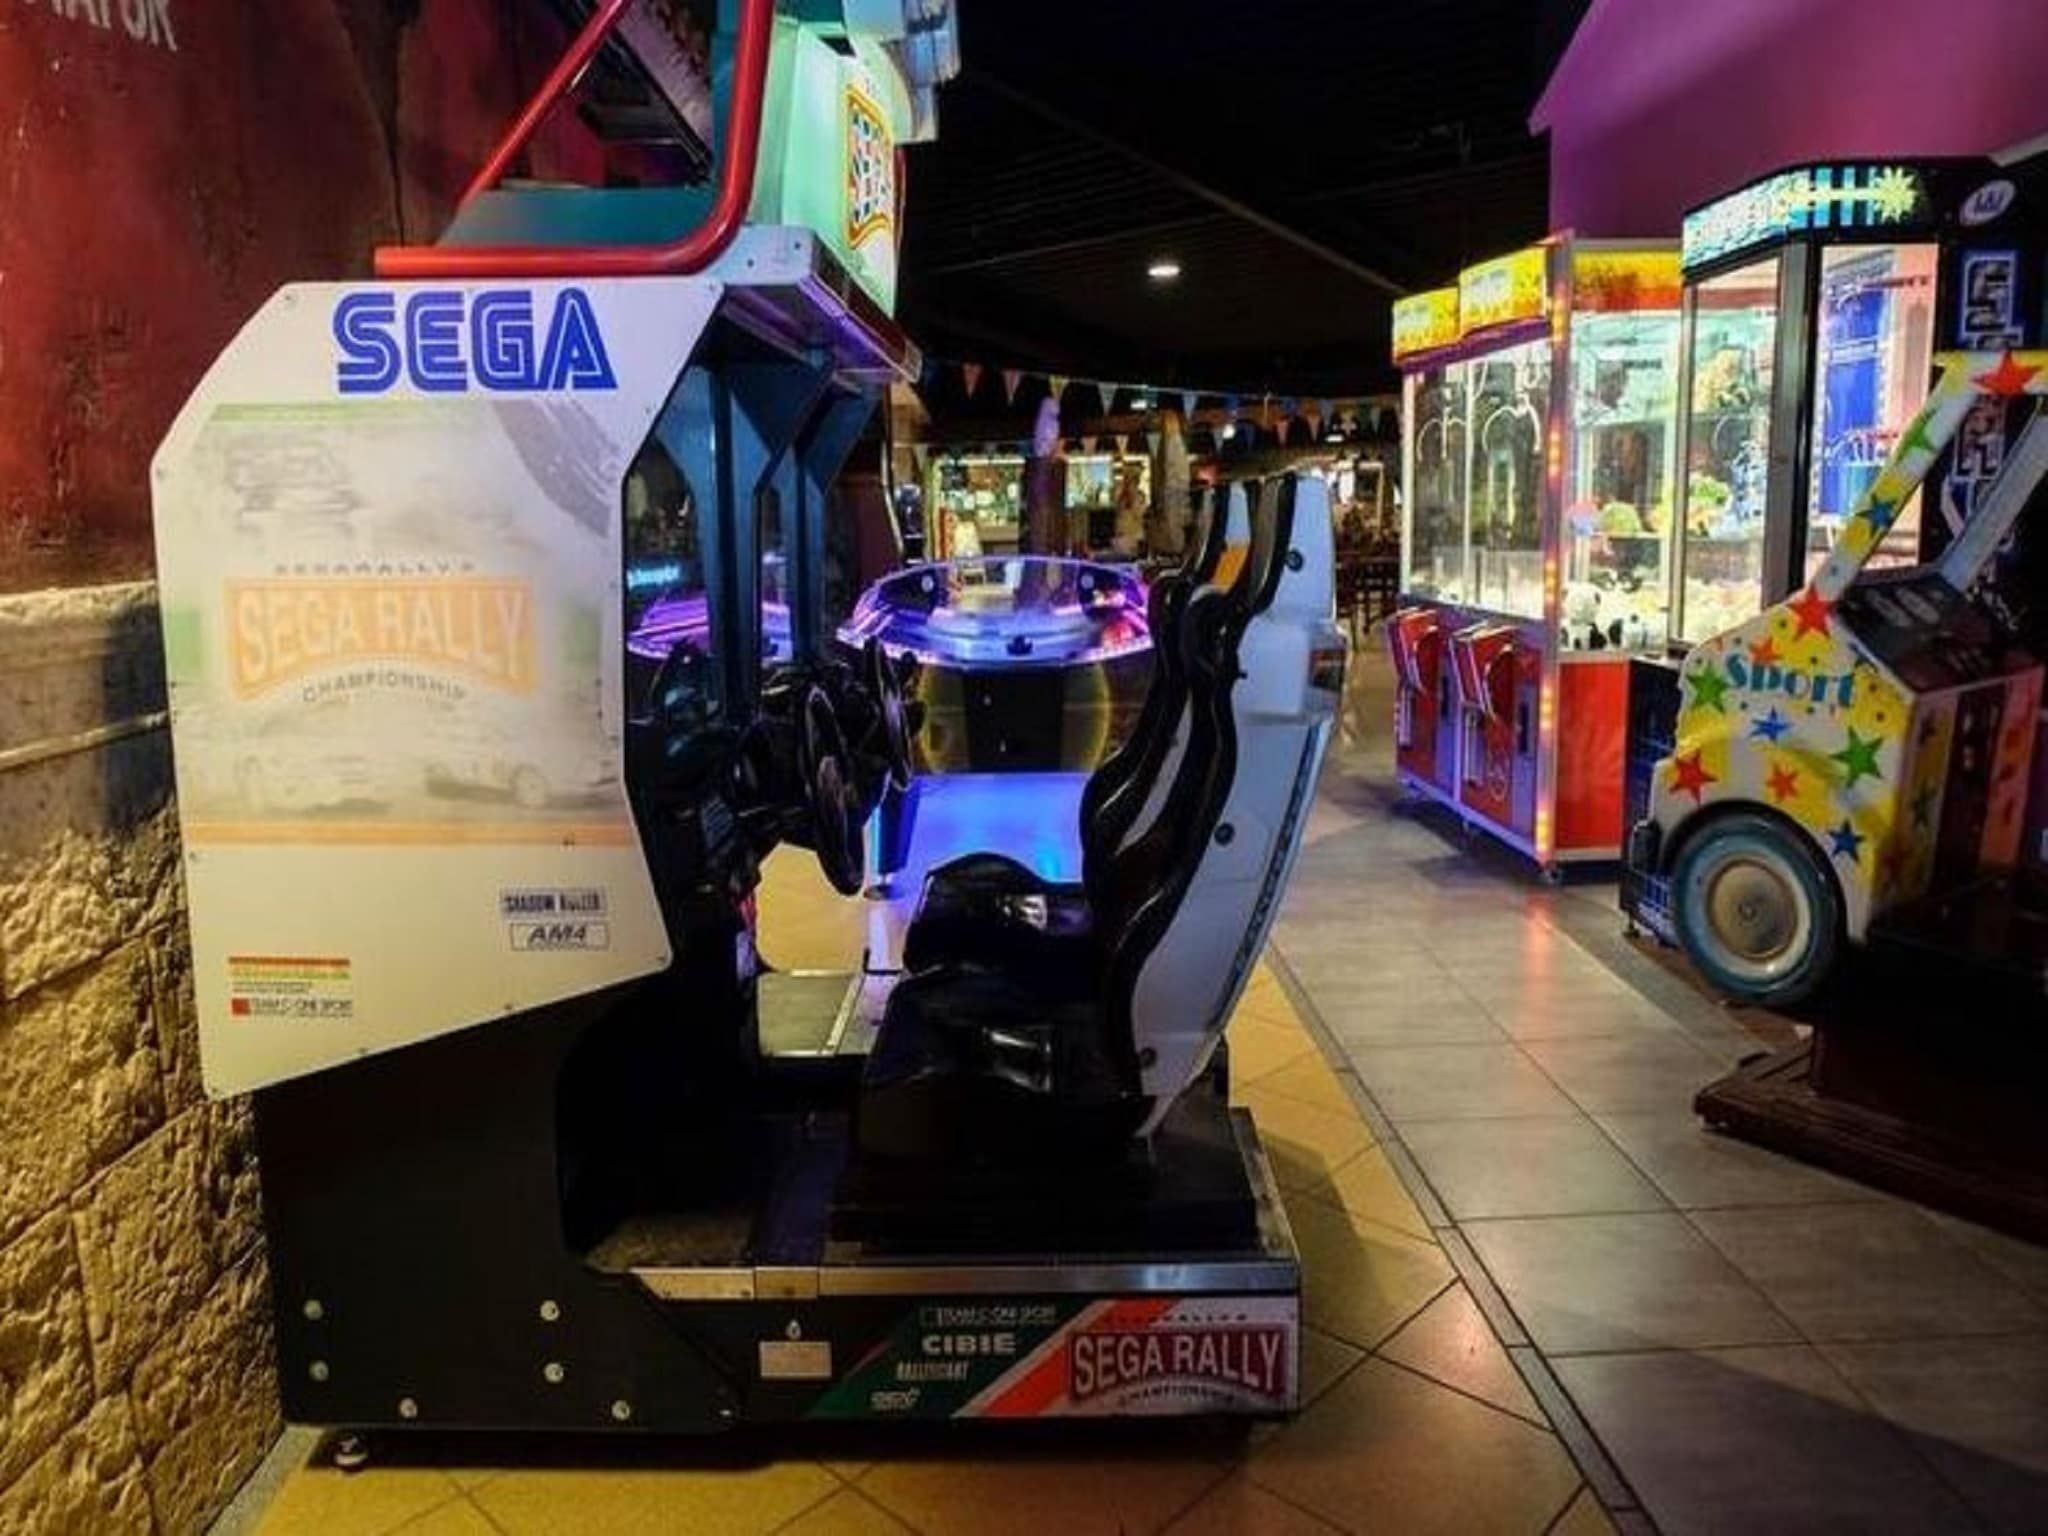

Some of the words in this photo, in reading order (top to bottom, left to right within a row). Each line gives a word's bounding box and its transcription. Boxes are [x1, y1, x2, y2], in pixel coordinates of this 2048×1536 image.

[333, 286, 618, 393] SEGA
[238, 586, 363, 681] SEGA
[377, 586, 528, 680] RALLY
[920, 1332, 1017, 1356] CIBIE
[1074, 1333, 1164, 1396] SEGA
[1172, 1331, 1282, 1393] RALLY
